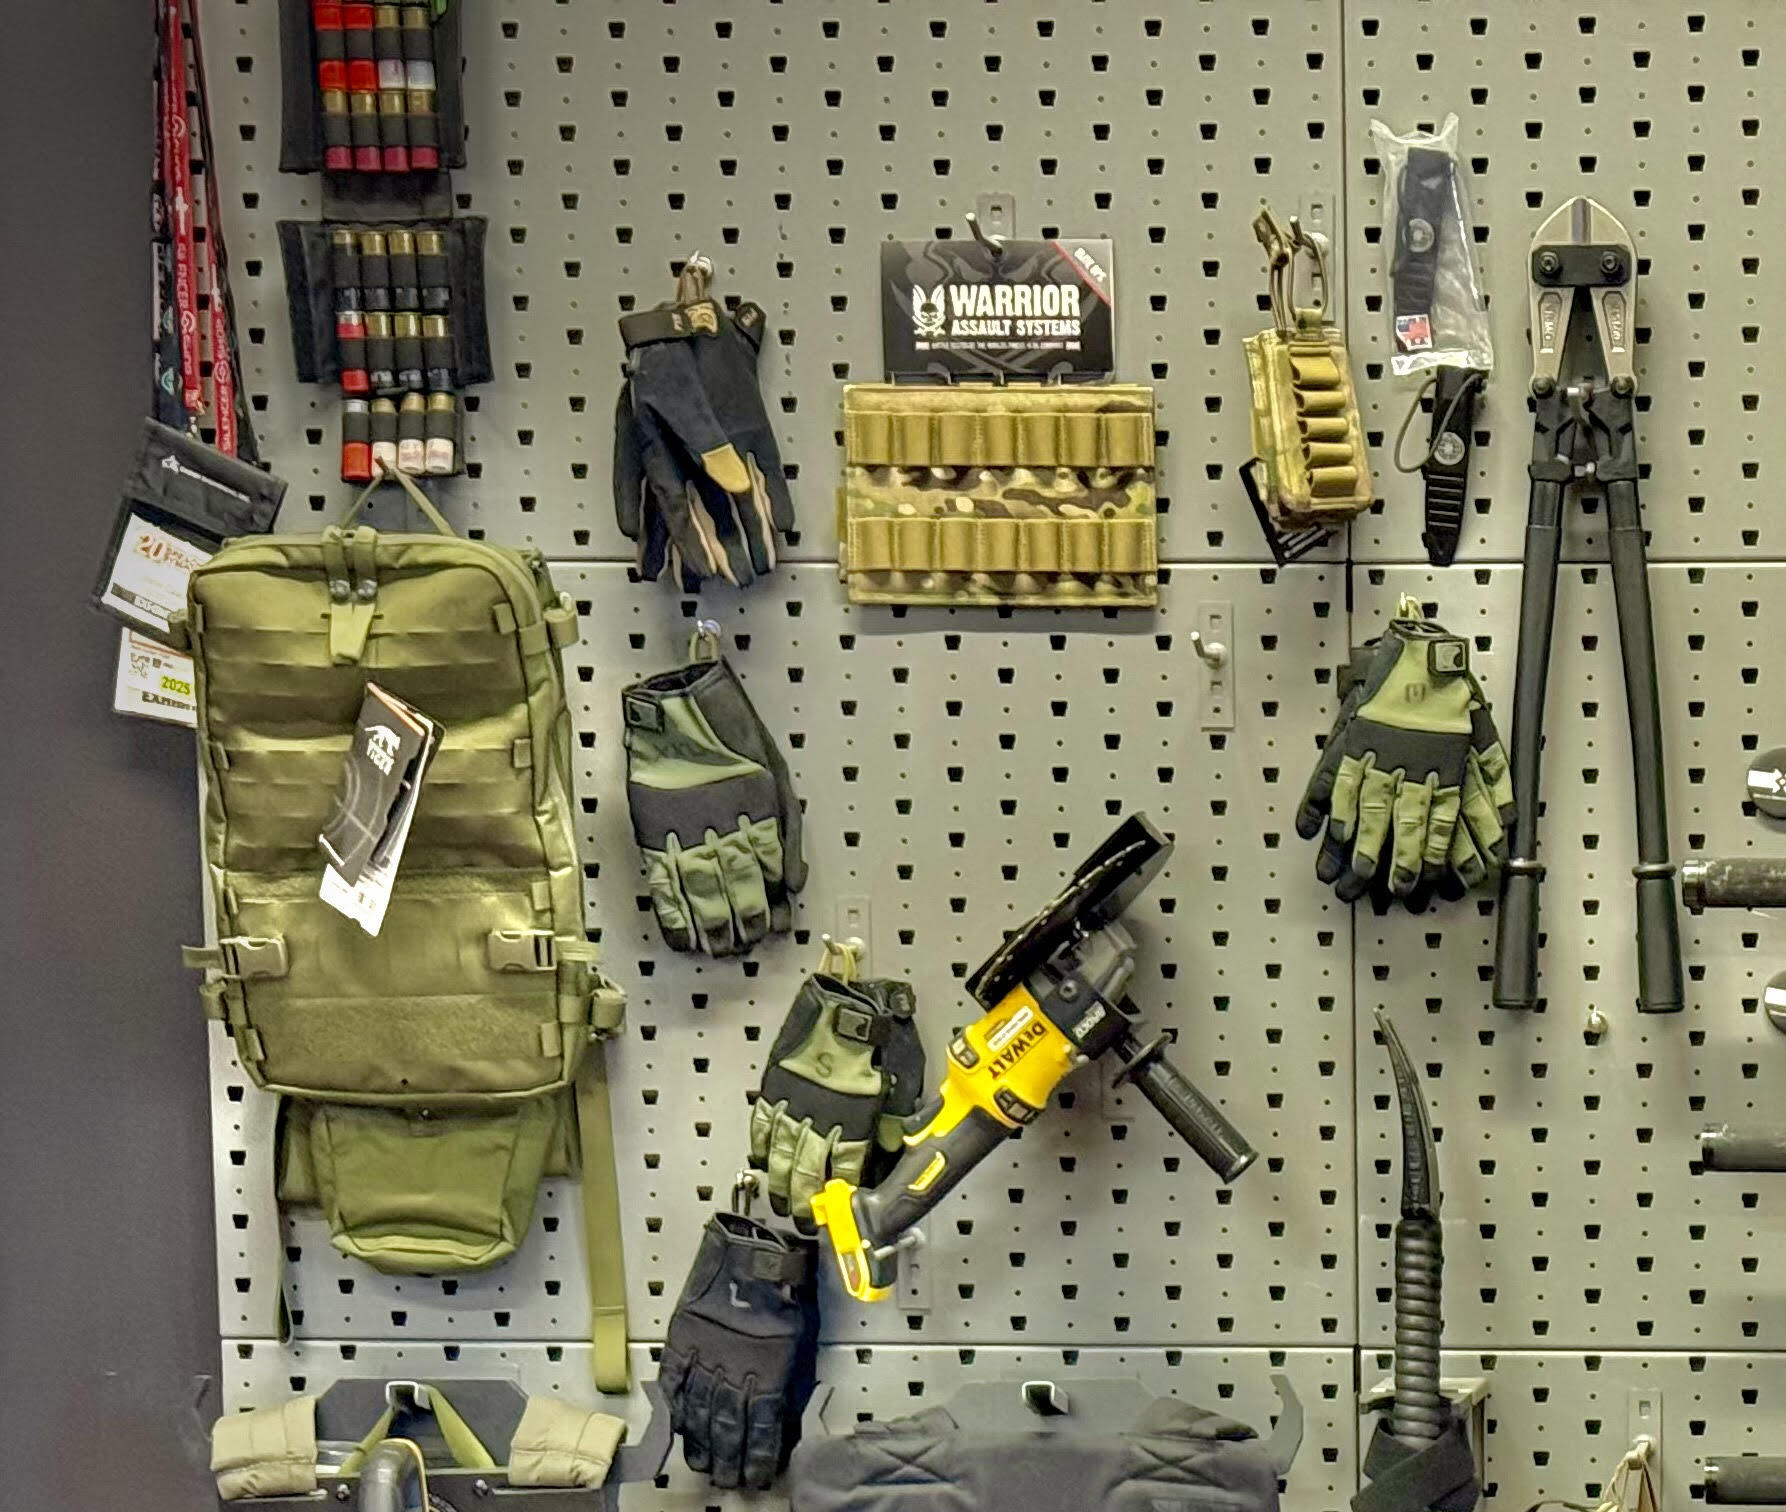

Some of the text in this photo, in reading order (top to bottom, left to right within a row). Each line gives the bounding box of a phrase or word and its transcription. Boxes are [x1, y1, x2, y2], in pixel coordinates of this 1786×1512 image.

[950, 284, 1081, 317] WARRIOR
[951, 319, 1081, 336] ASSAULT SYSTEMS
[161, 675, 191, 697] 2025
[815, 1051, 835, 1079] S
[729, 1282, 751, 1308] L
